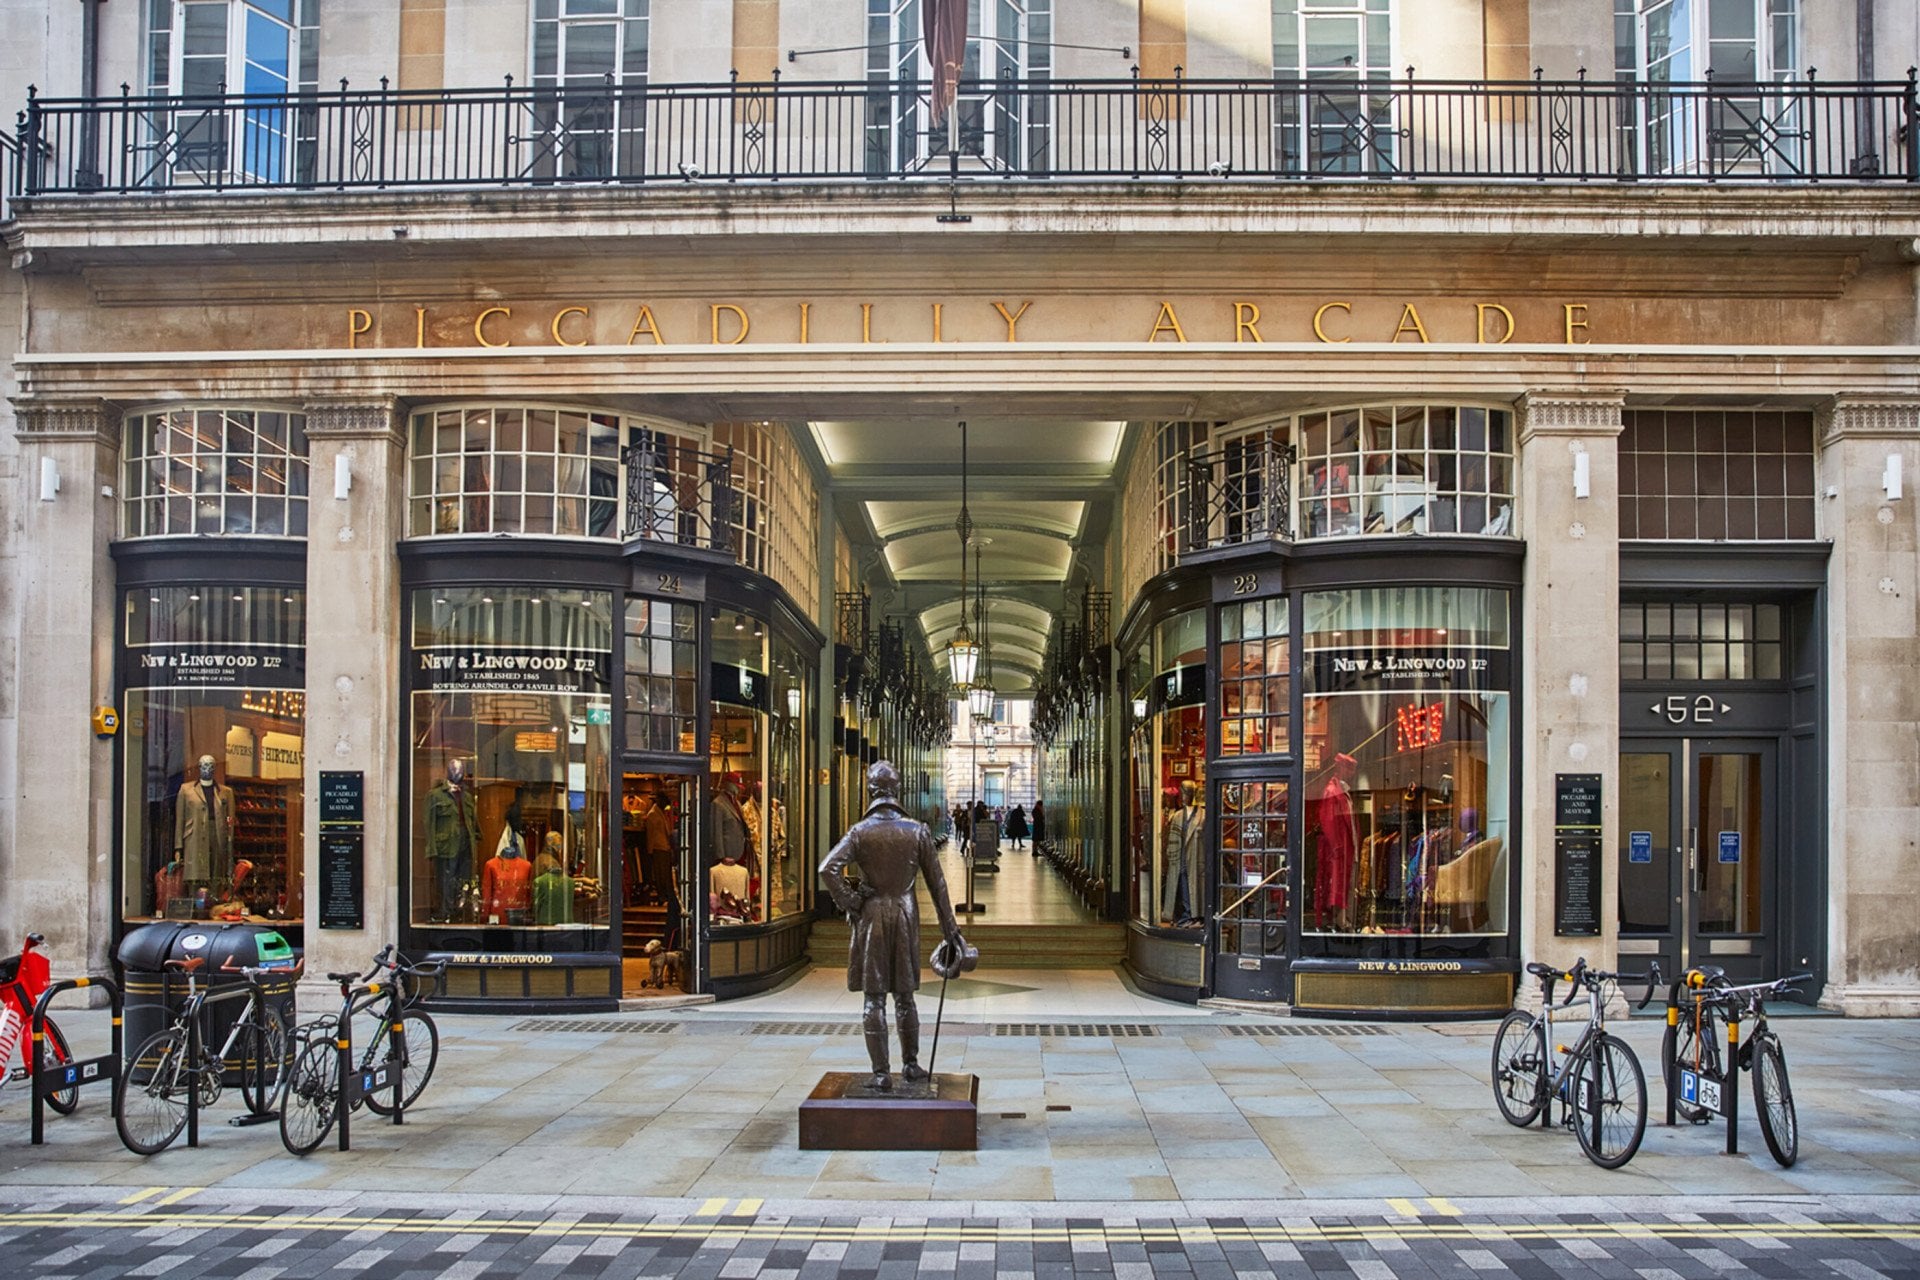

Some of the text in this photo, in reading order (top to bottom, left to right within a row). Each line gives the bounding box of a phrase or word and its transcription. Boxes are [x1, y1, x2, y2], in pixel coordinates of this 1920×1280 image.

[348, 302, 1592, 349] PICCADILLY ARCADE
[657, 574, 682, 594] 24
[1233, 574, 1258, 595] 23
[169, 656, 178, 667] &
[180, 652, 257, 667] LINGWOOD
[420, 653, 454, 669] NEW
[458, 656, 468, 669] &
[472, 652, 567, 670] LINGWOOD
[1333, 658, 1369, 672] NEW
[1372, 659, 1382, 670] &
[1385, 656, 1466, 670] LINGWOOD
[464, 672, 539, 680] ESTABLISHED 1865
[1381, 671, 1430, 679] ESTABLISHED
[471, 682, 510, 690] ARUNDEL
[526, 683, 555, 691] SAVILE
[557, 684, 579, 692] ROW
[1666, 695, 1714, 723] 52
[1397, 702, 1444, 752] NEW
[1247, 823, 1258, 832] 52
[452, 954, 553, 964] NEW & LINGWOOD
[1358, 961, 1461, 972] NEW & LINGWOOD
[1684, 1073, 1694, 1098] P
